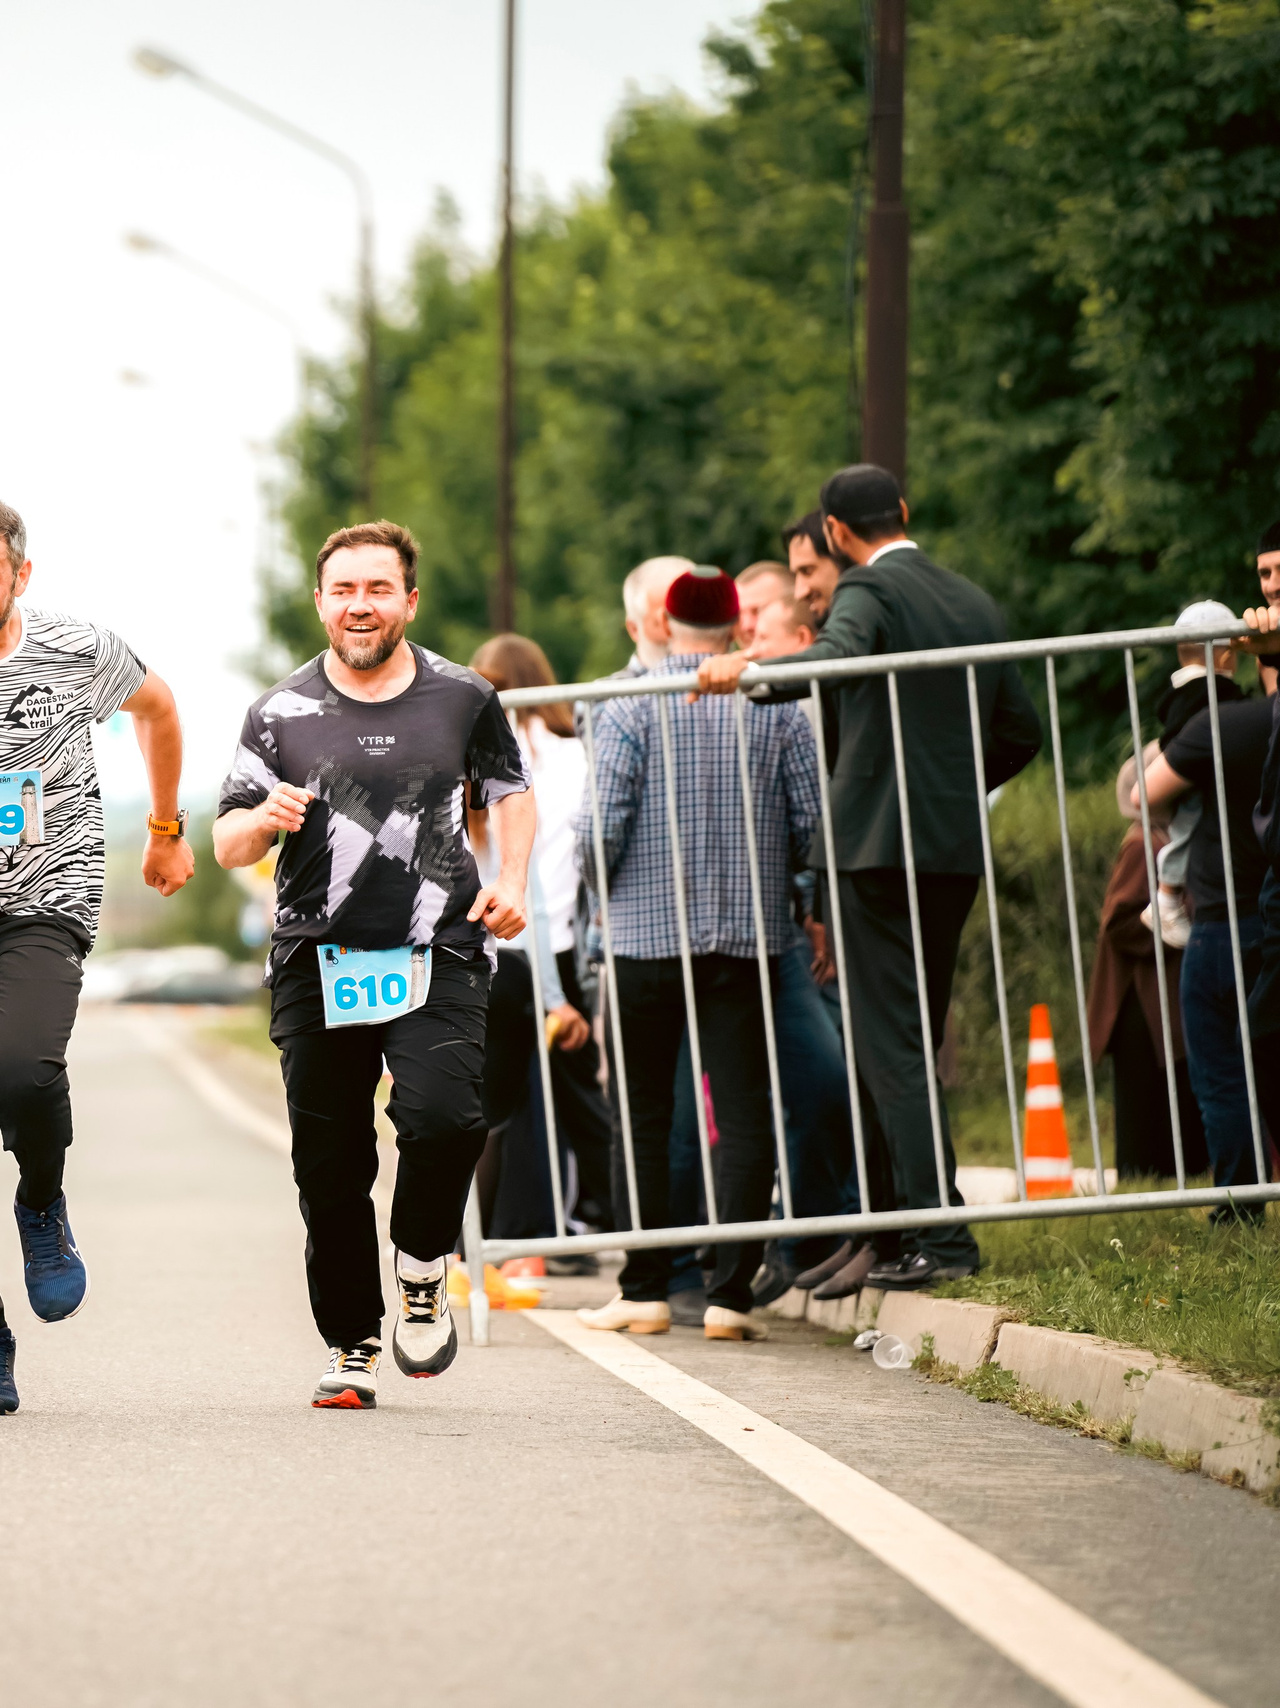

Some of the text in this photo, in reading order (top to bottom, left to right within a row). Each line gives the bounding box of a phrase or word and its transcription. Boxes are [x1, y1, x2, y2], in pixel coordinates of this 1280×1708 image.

[26, 692, 74, 706] DAGESTAN
[26, 703, 64, 718] WILD
[29, 717, 53, 729] trail
[357, 736, 384, 745] VTR
[334, 973, 407, 1010] 610
